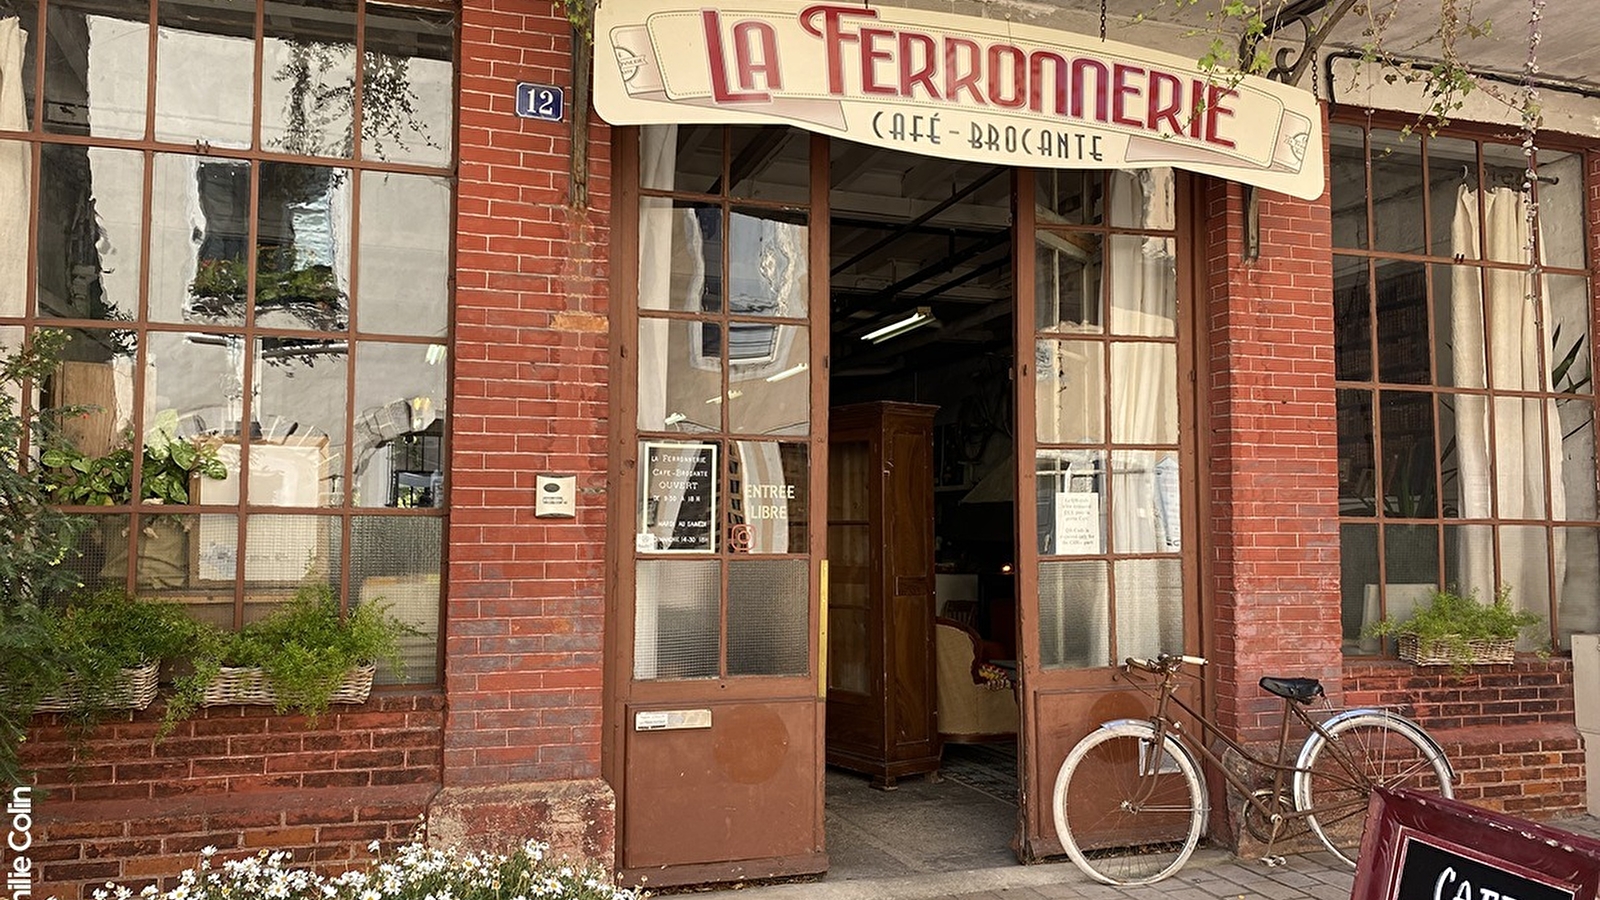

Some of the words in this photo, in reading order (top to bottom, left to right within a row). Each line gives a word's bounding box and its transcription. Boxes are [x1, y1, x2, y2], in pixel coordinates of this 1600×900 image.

[700, 9, 783, 105] LA
[799, 4, 1240, 149] FERRONNERIE
[527, 88, 554, 116] 12
[967, 121, 1103, 162] BROCANTE
[659, 481, 698, 490] OUVERT
[747, 484, 795, 499] ENTREE
[751, 505, 787, 519] LIBRE
